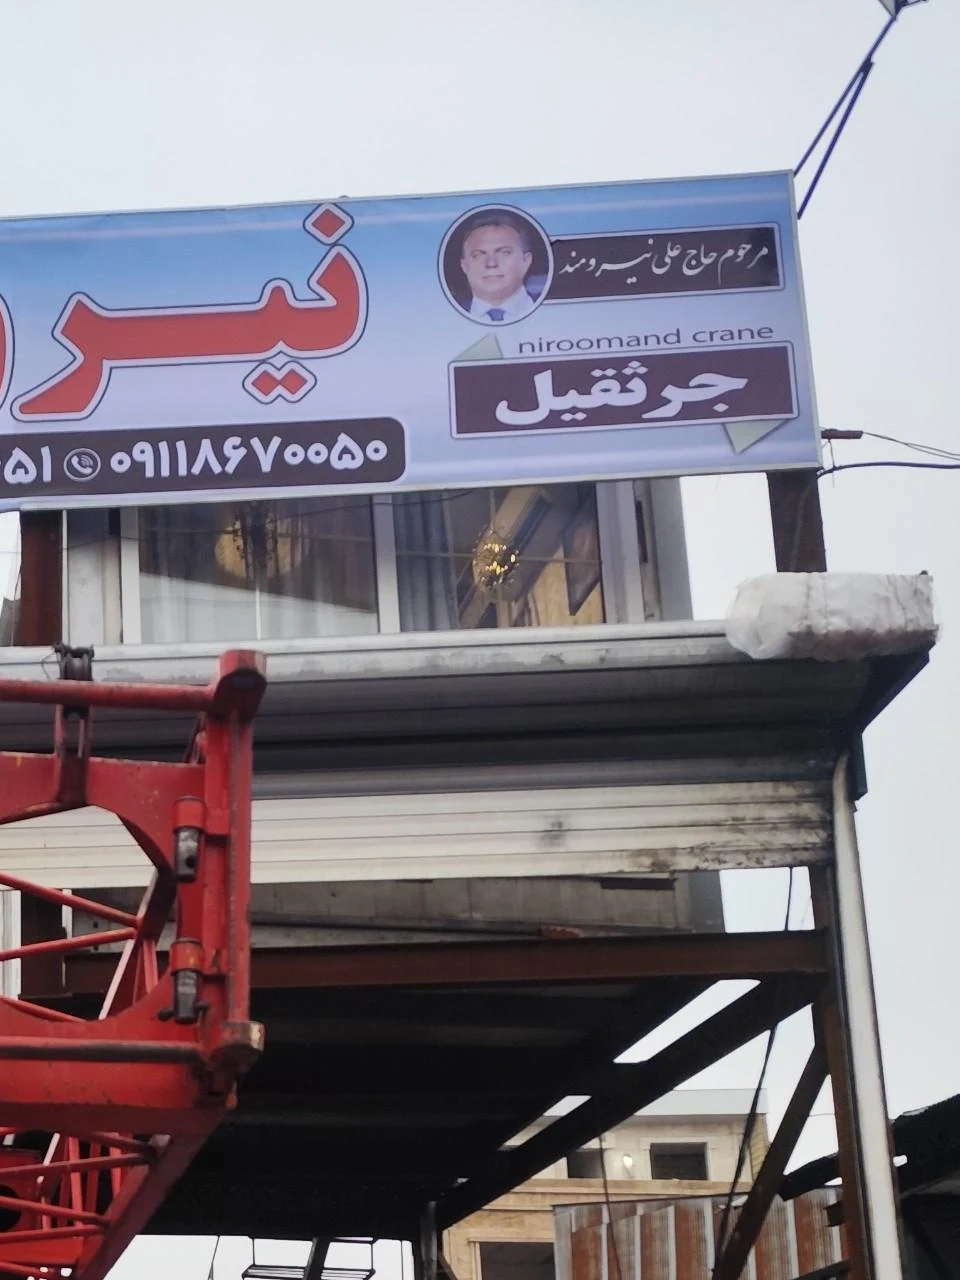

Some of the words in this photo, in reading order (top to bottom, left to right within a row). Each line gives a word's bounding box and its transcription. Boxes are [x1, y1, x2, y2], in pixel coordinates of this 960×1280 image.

[559, 238, 653, 284] نیرومند
[651, 240, 682, 275] علی
[682, 243, 718, 276] حاج
[717, 241, 769, 285] مرحوم
[518, 327, 681, 355] niroomand
[692, 325, 774, 344] crane
[494, 360, 749, 426] جرثقیل
[110, 432, 388, 478] ۰۹۱۱۸۶۷۰۰۵۰
